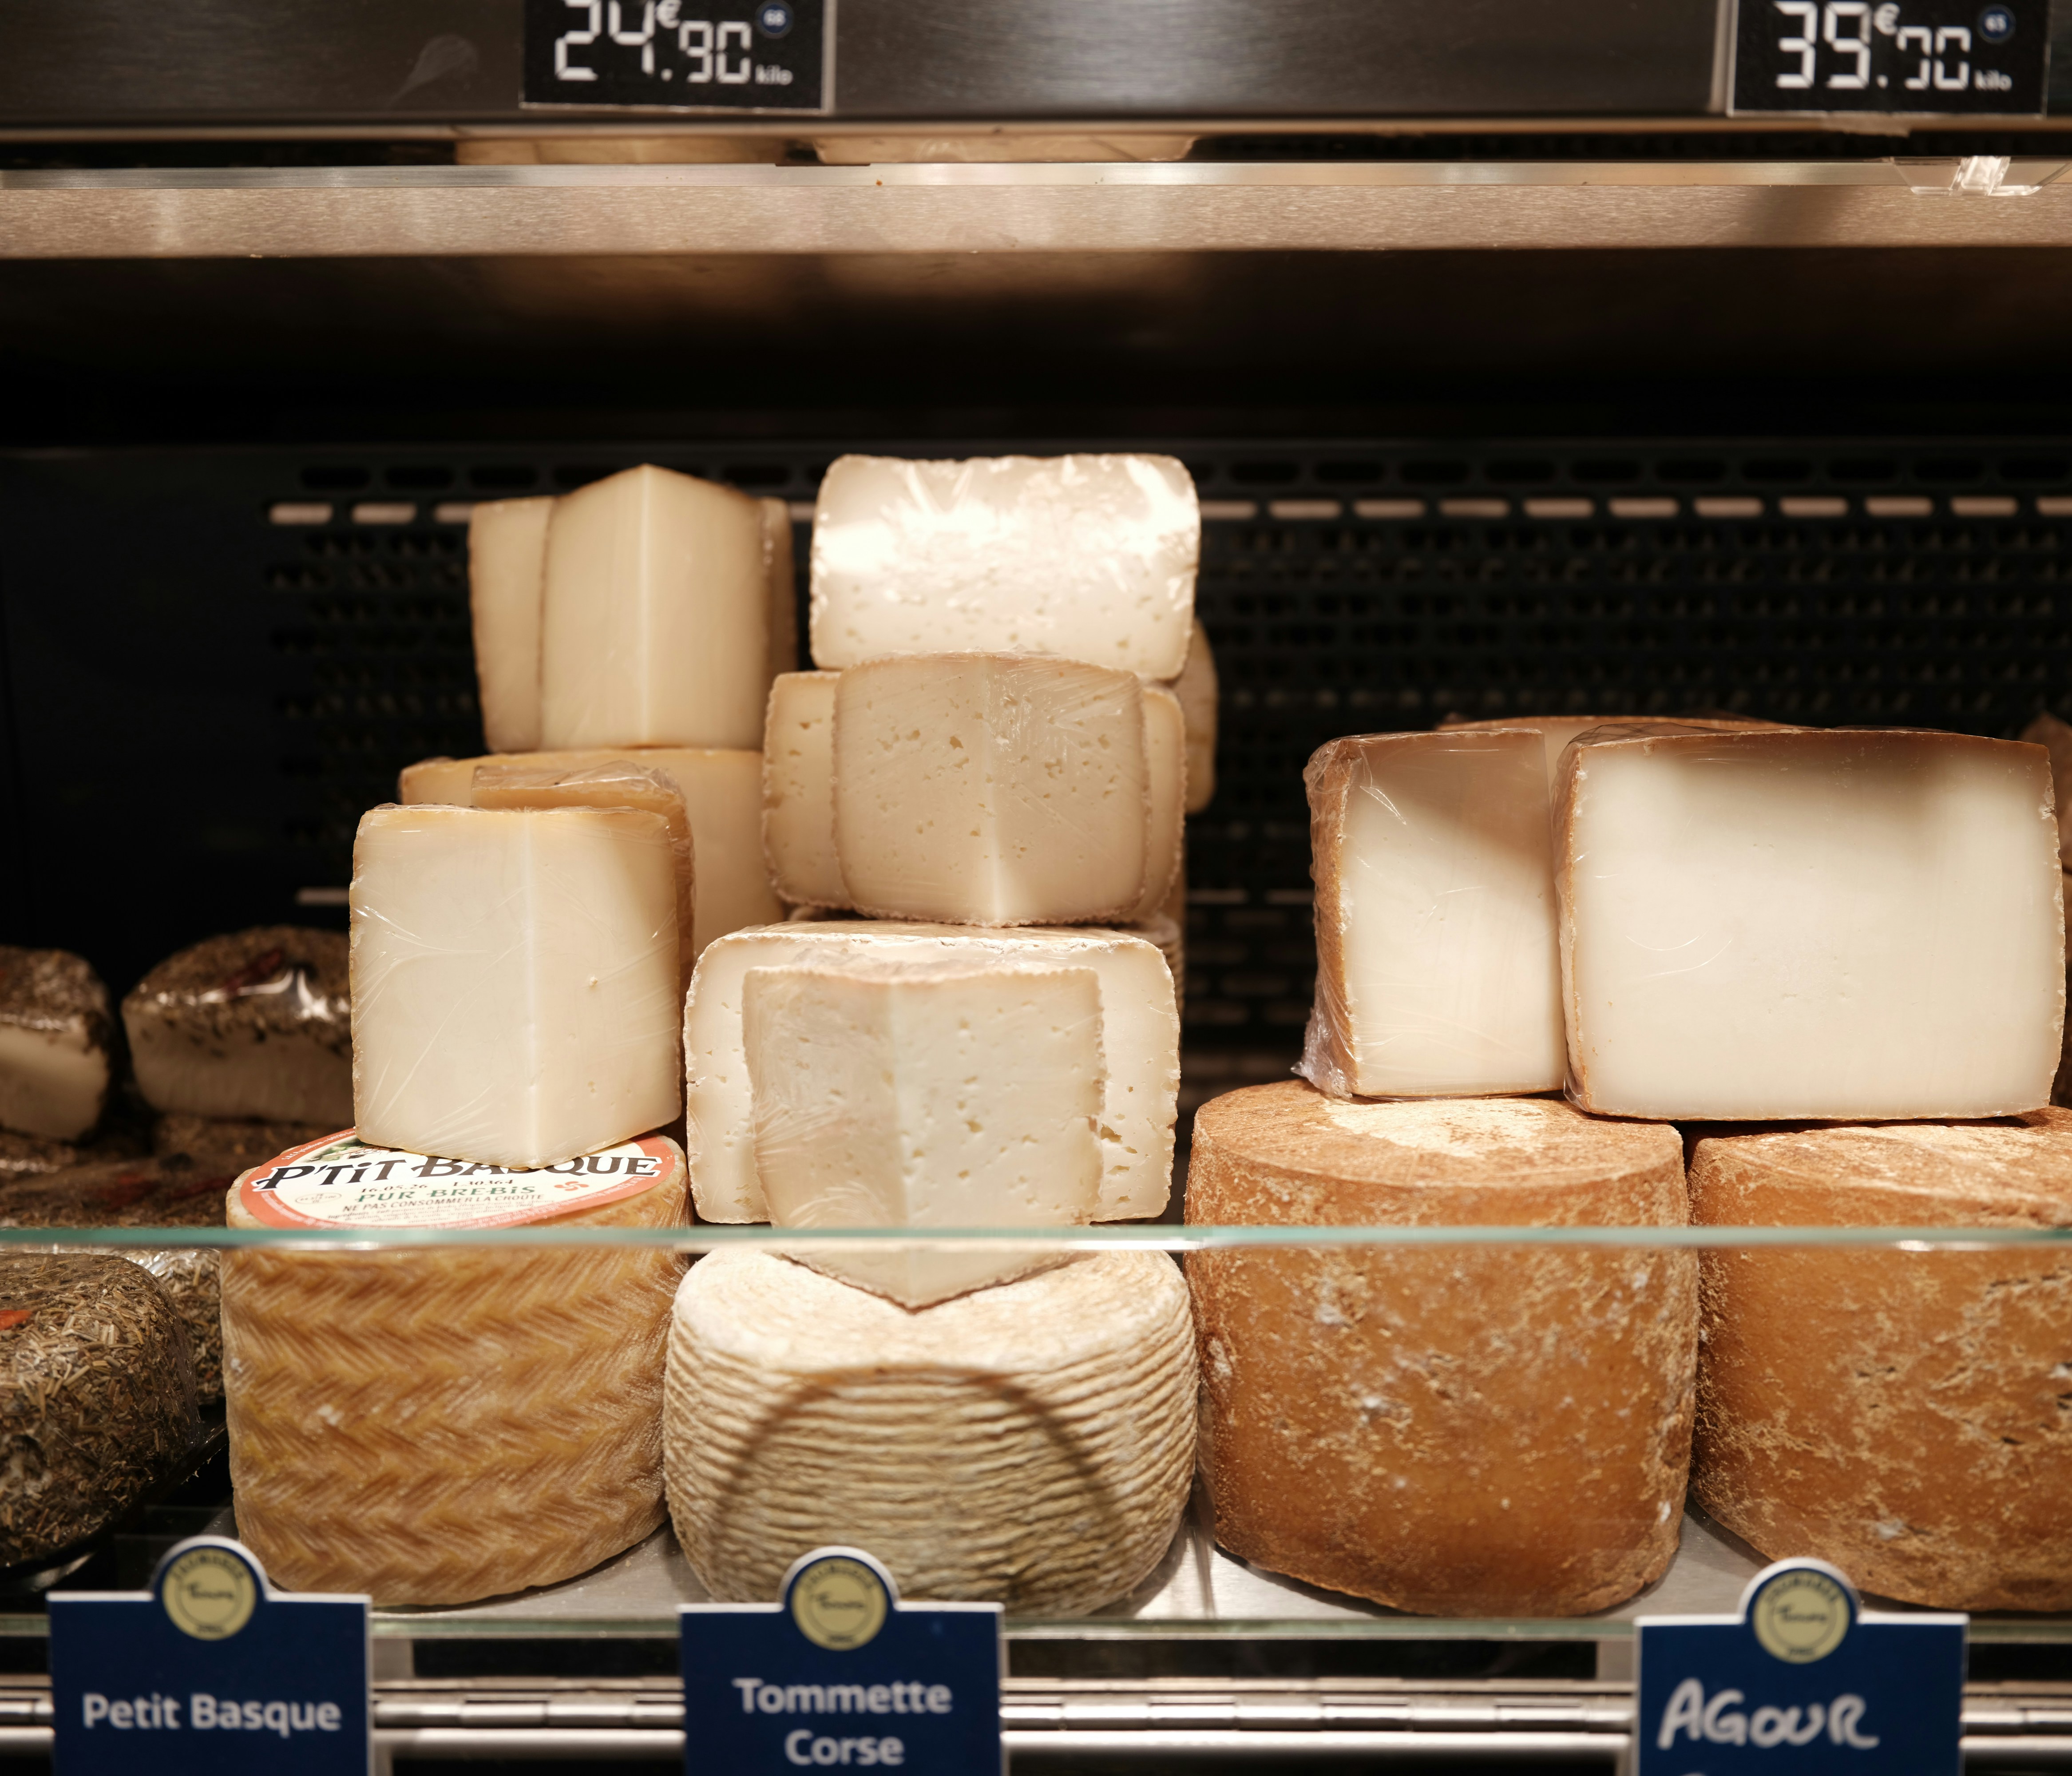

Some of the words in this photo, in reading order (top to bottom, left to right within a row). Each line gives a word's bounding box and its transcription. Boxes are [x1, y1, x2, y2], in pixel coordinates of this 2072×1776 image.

[756, 65, 793, 85] kilo
[1974, 70, 2012, 91] kilo
[410, 1155, 658, 1177] BAQUE
[342, 1204, 358, 1212] NE
[390, 1197, 472, 1208] CONSOMMER
[355, 1191, 416, 1202] PUR
[732, 1678, 952, 1714] Tommette
[82, 1692, 181, 1729] Petit
[190, 1693, 341, 1738] Basque
[784, 1729, 904, 1765] Corse
